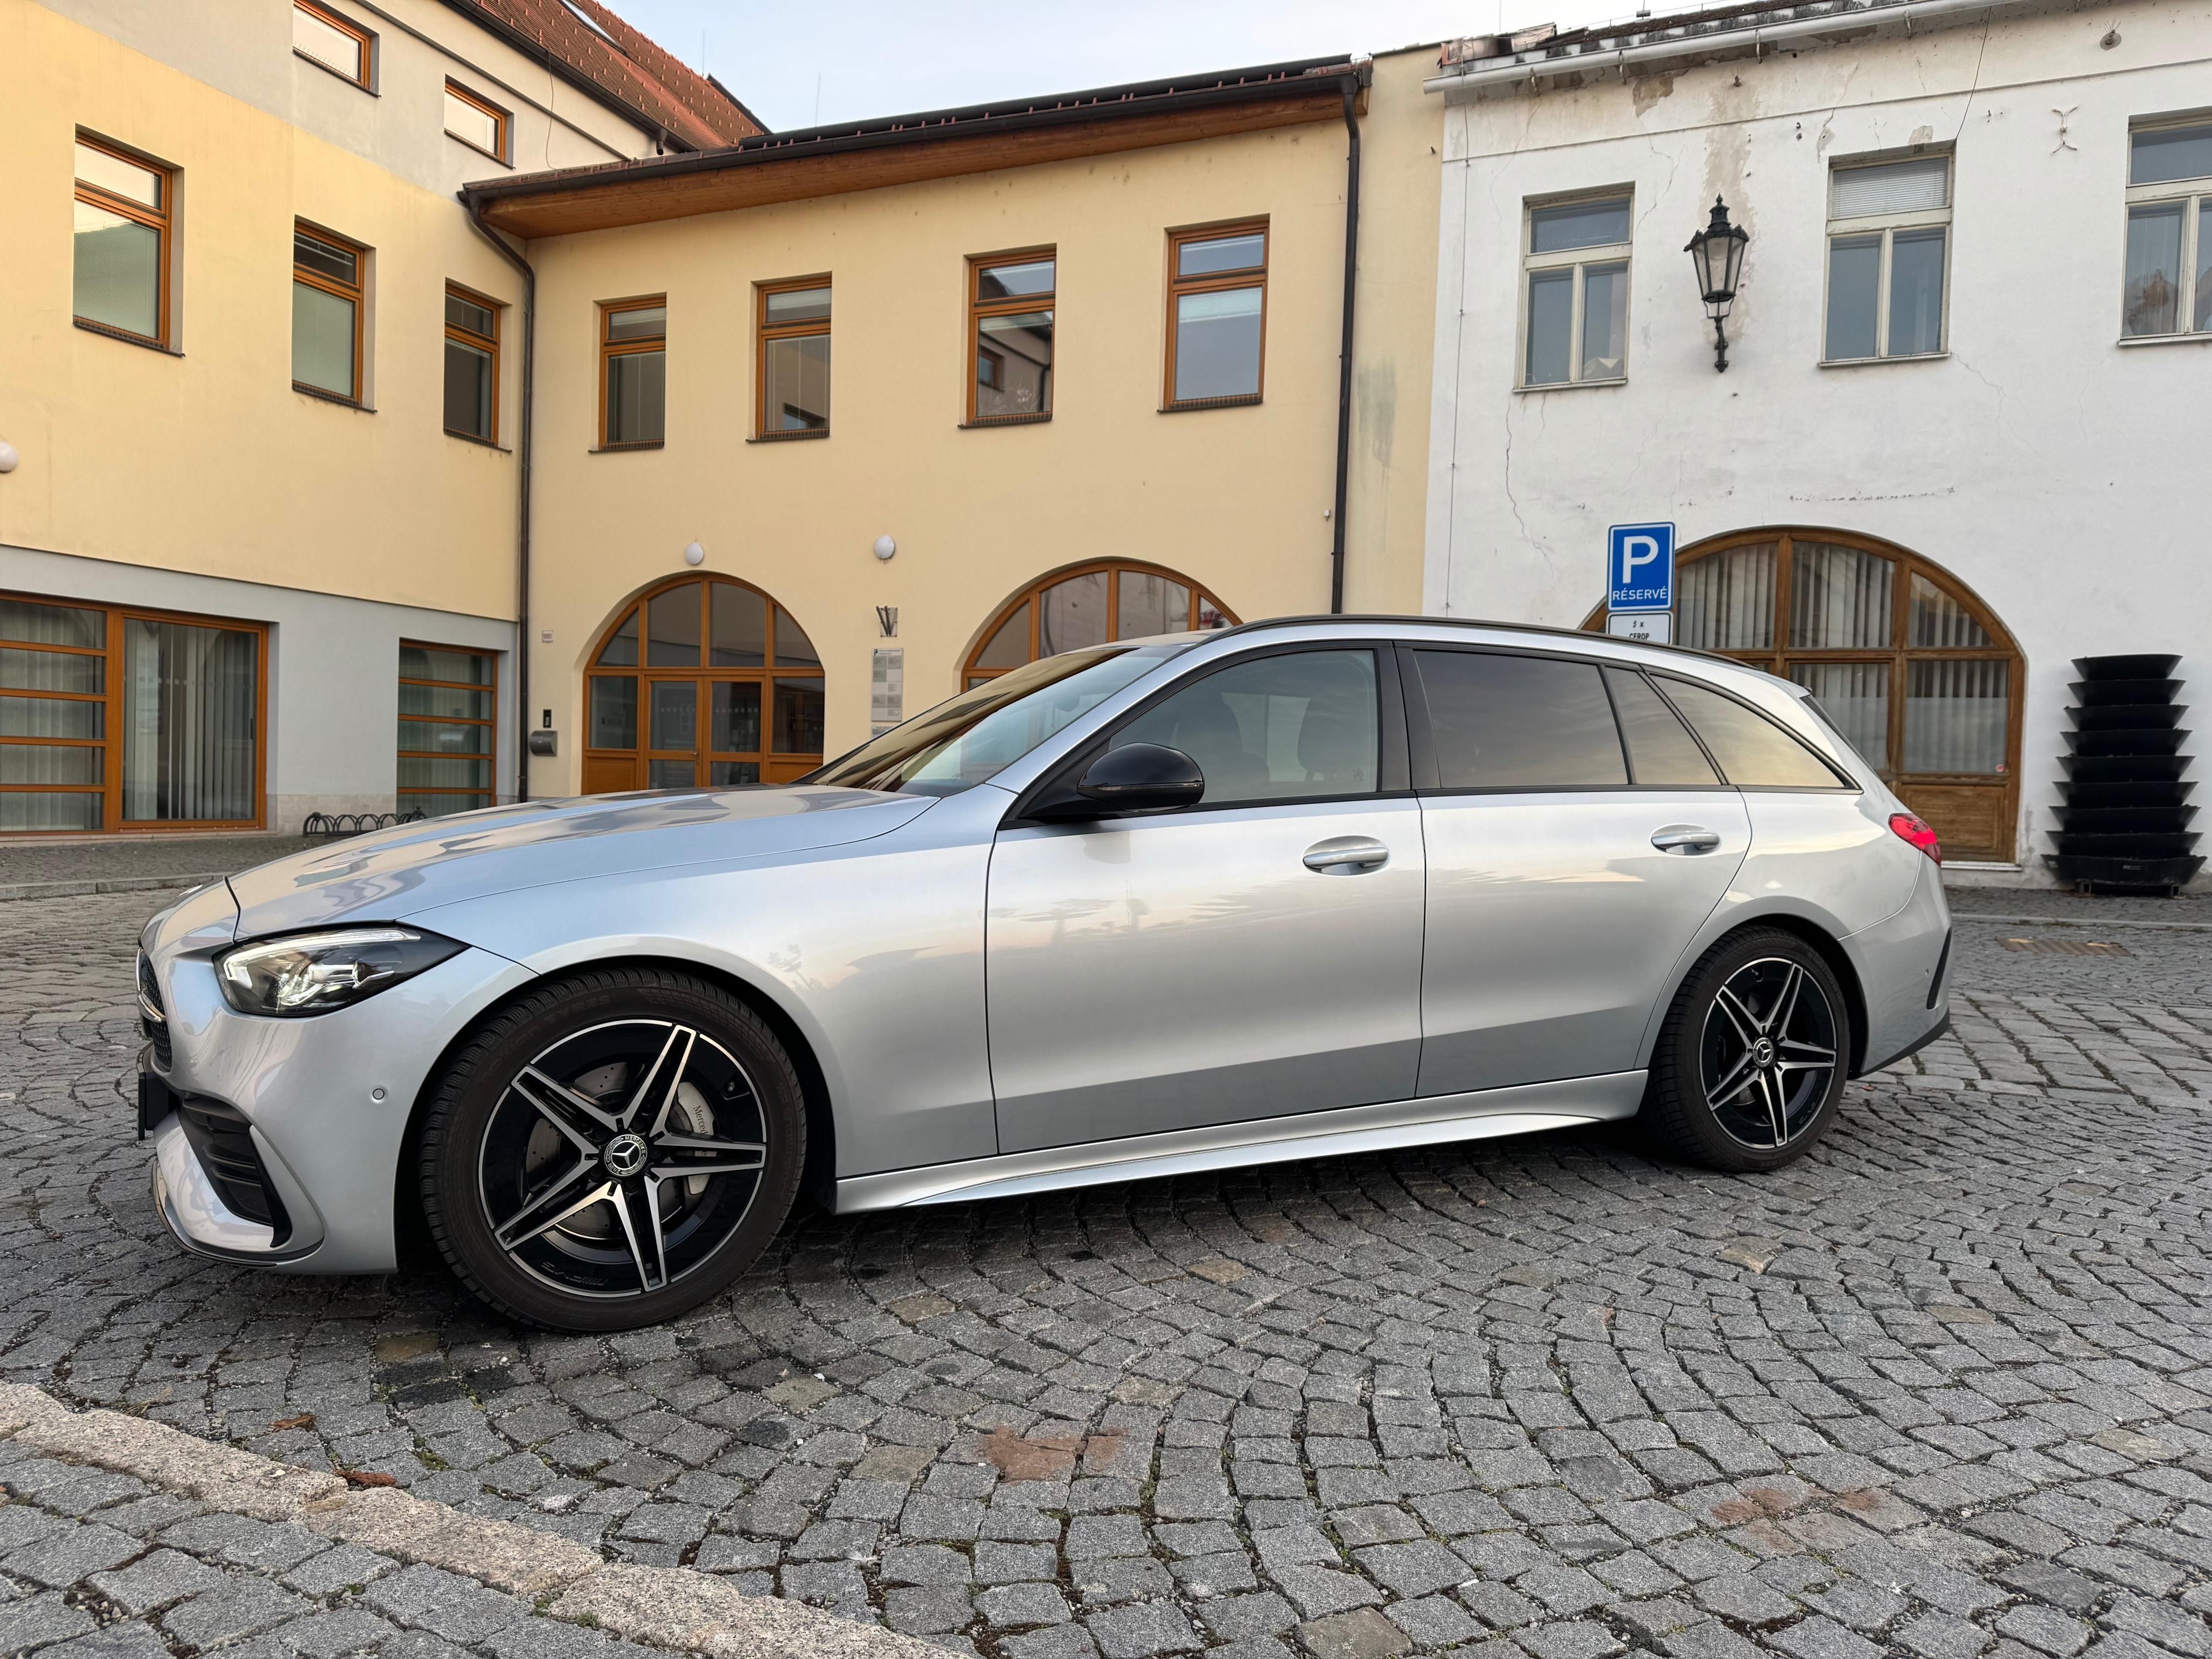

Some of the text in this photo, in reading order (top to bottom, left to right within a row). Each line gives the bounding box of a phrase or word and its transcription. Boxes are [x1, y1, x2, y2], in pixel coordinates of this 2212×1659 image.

[1622, 535, 1658, 584] P
[1613, 586, 1668, 601] RÉSERVÉ
[1633, 620, 1637, 628] 5
[693, 1104, 709, 1135] Merced
[624, 1135, 646, 1155] MERCEDES
[607, 1162, 622, 1175] BENZ
